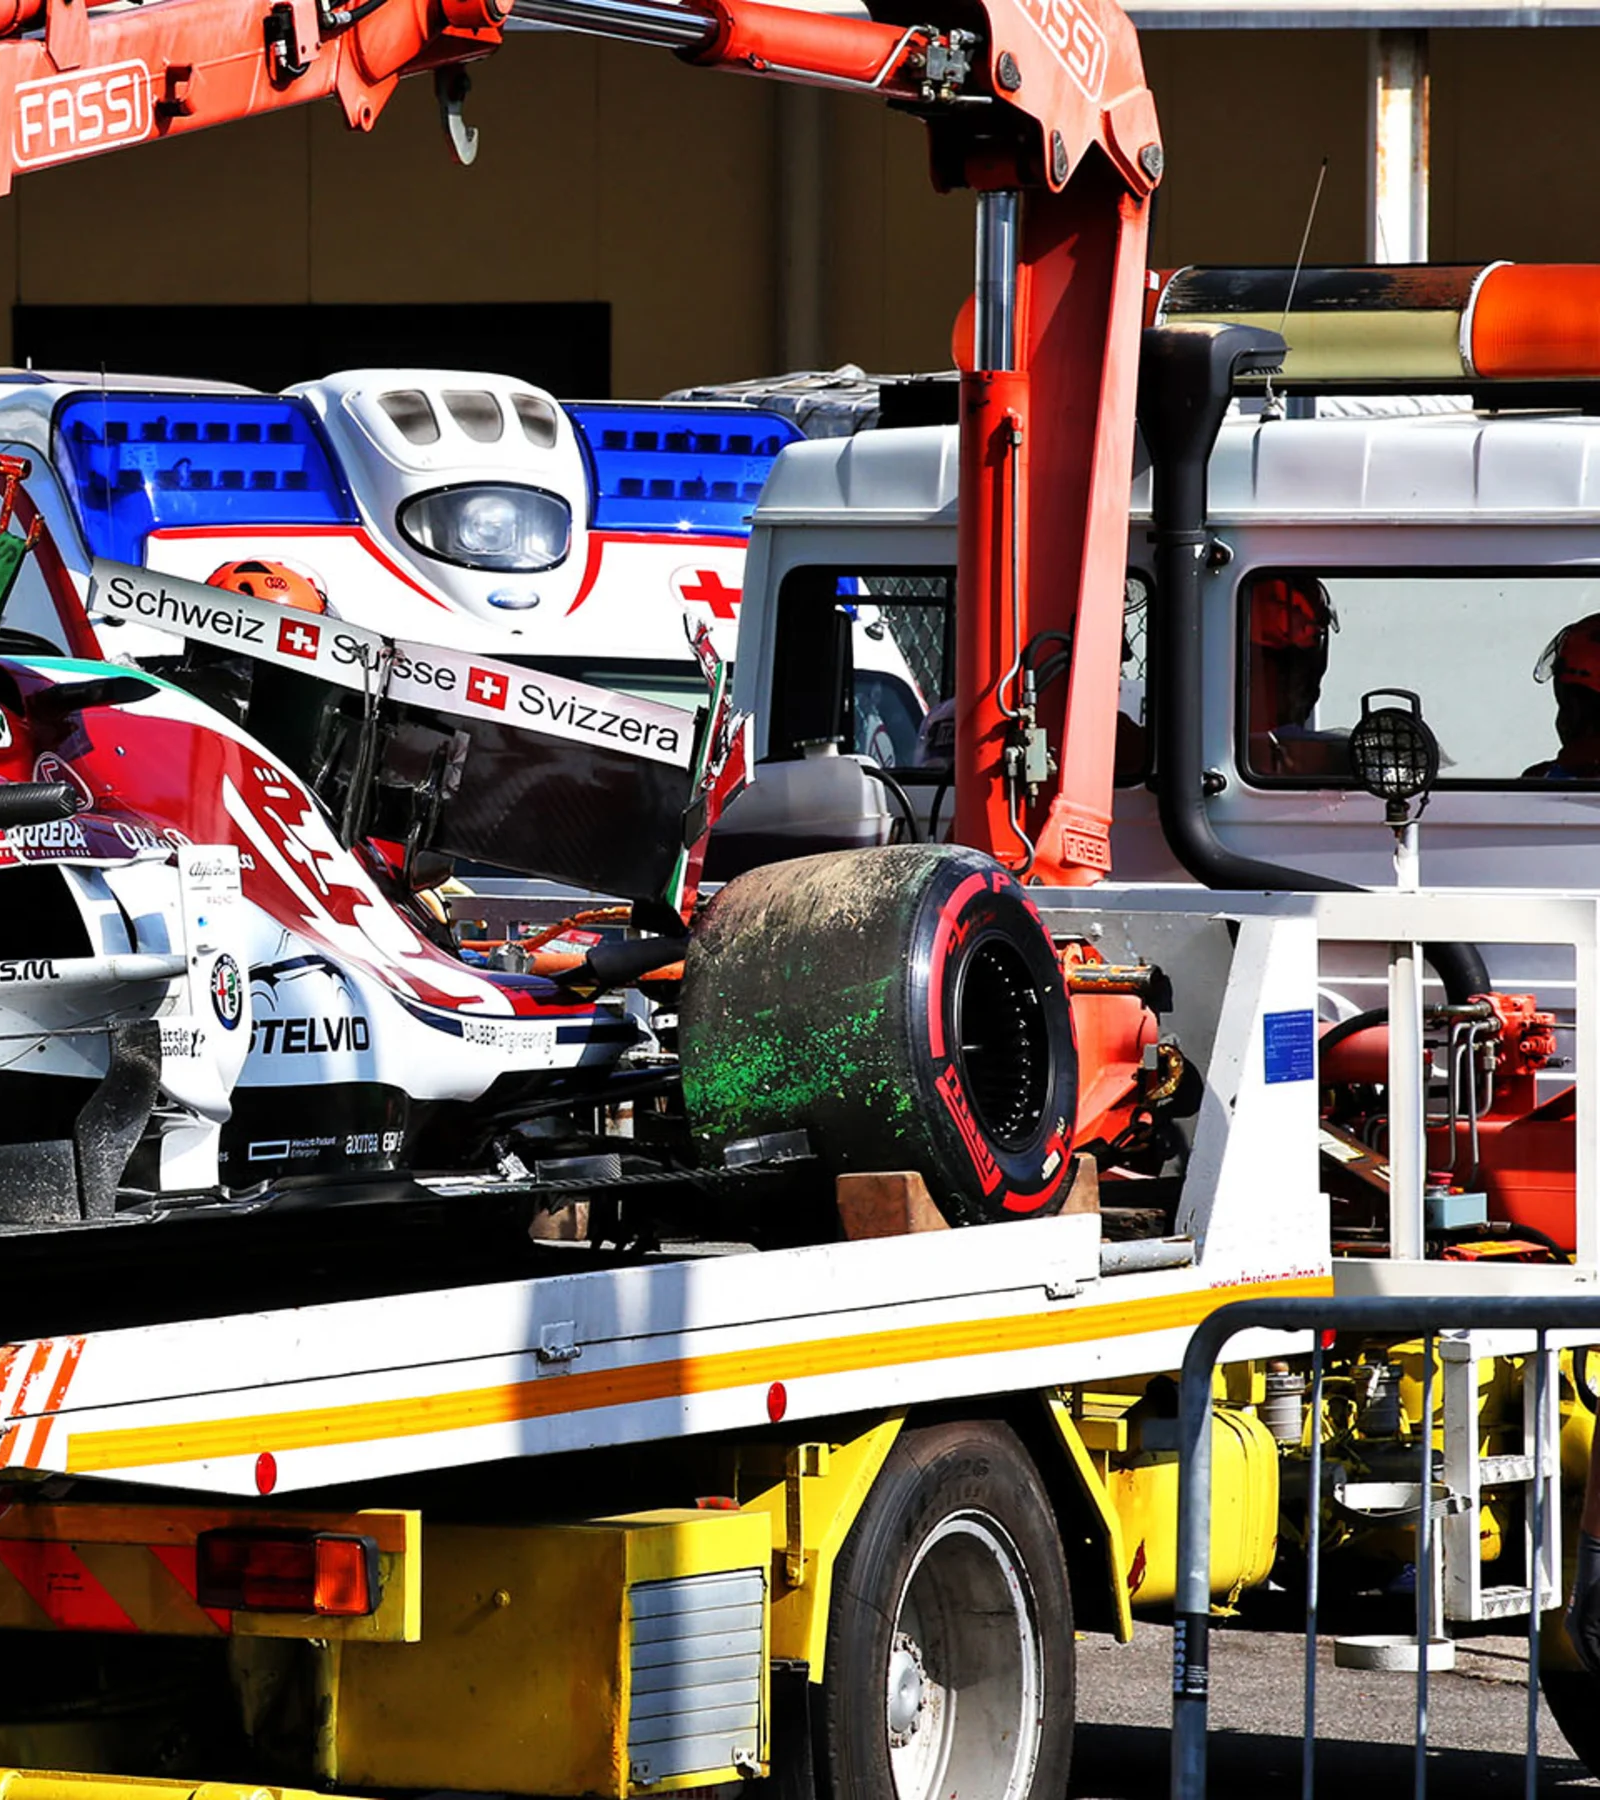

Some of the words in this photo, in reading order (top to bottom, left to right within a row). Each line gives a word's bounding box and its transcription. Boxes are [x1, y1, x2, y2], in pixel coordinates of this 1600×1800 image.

[19, 72, 143, 154] FASSI
[106, 577, 267, 644] Schweiz
[330, 633, 458, 692] Susse
[518, 684, 681, 754] Svizzera
[933, 1063, 1004, 1197] PIRELLI
